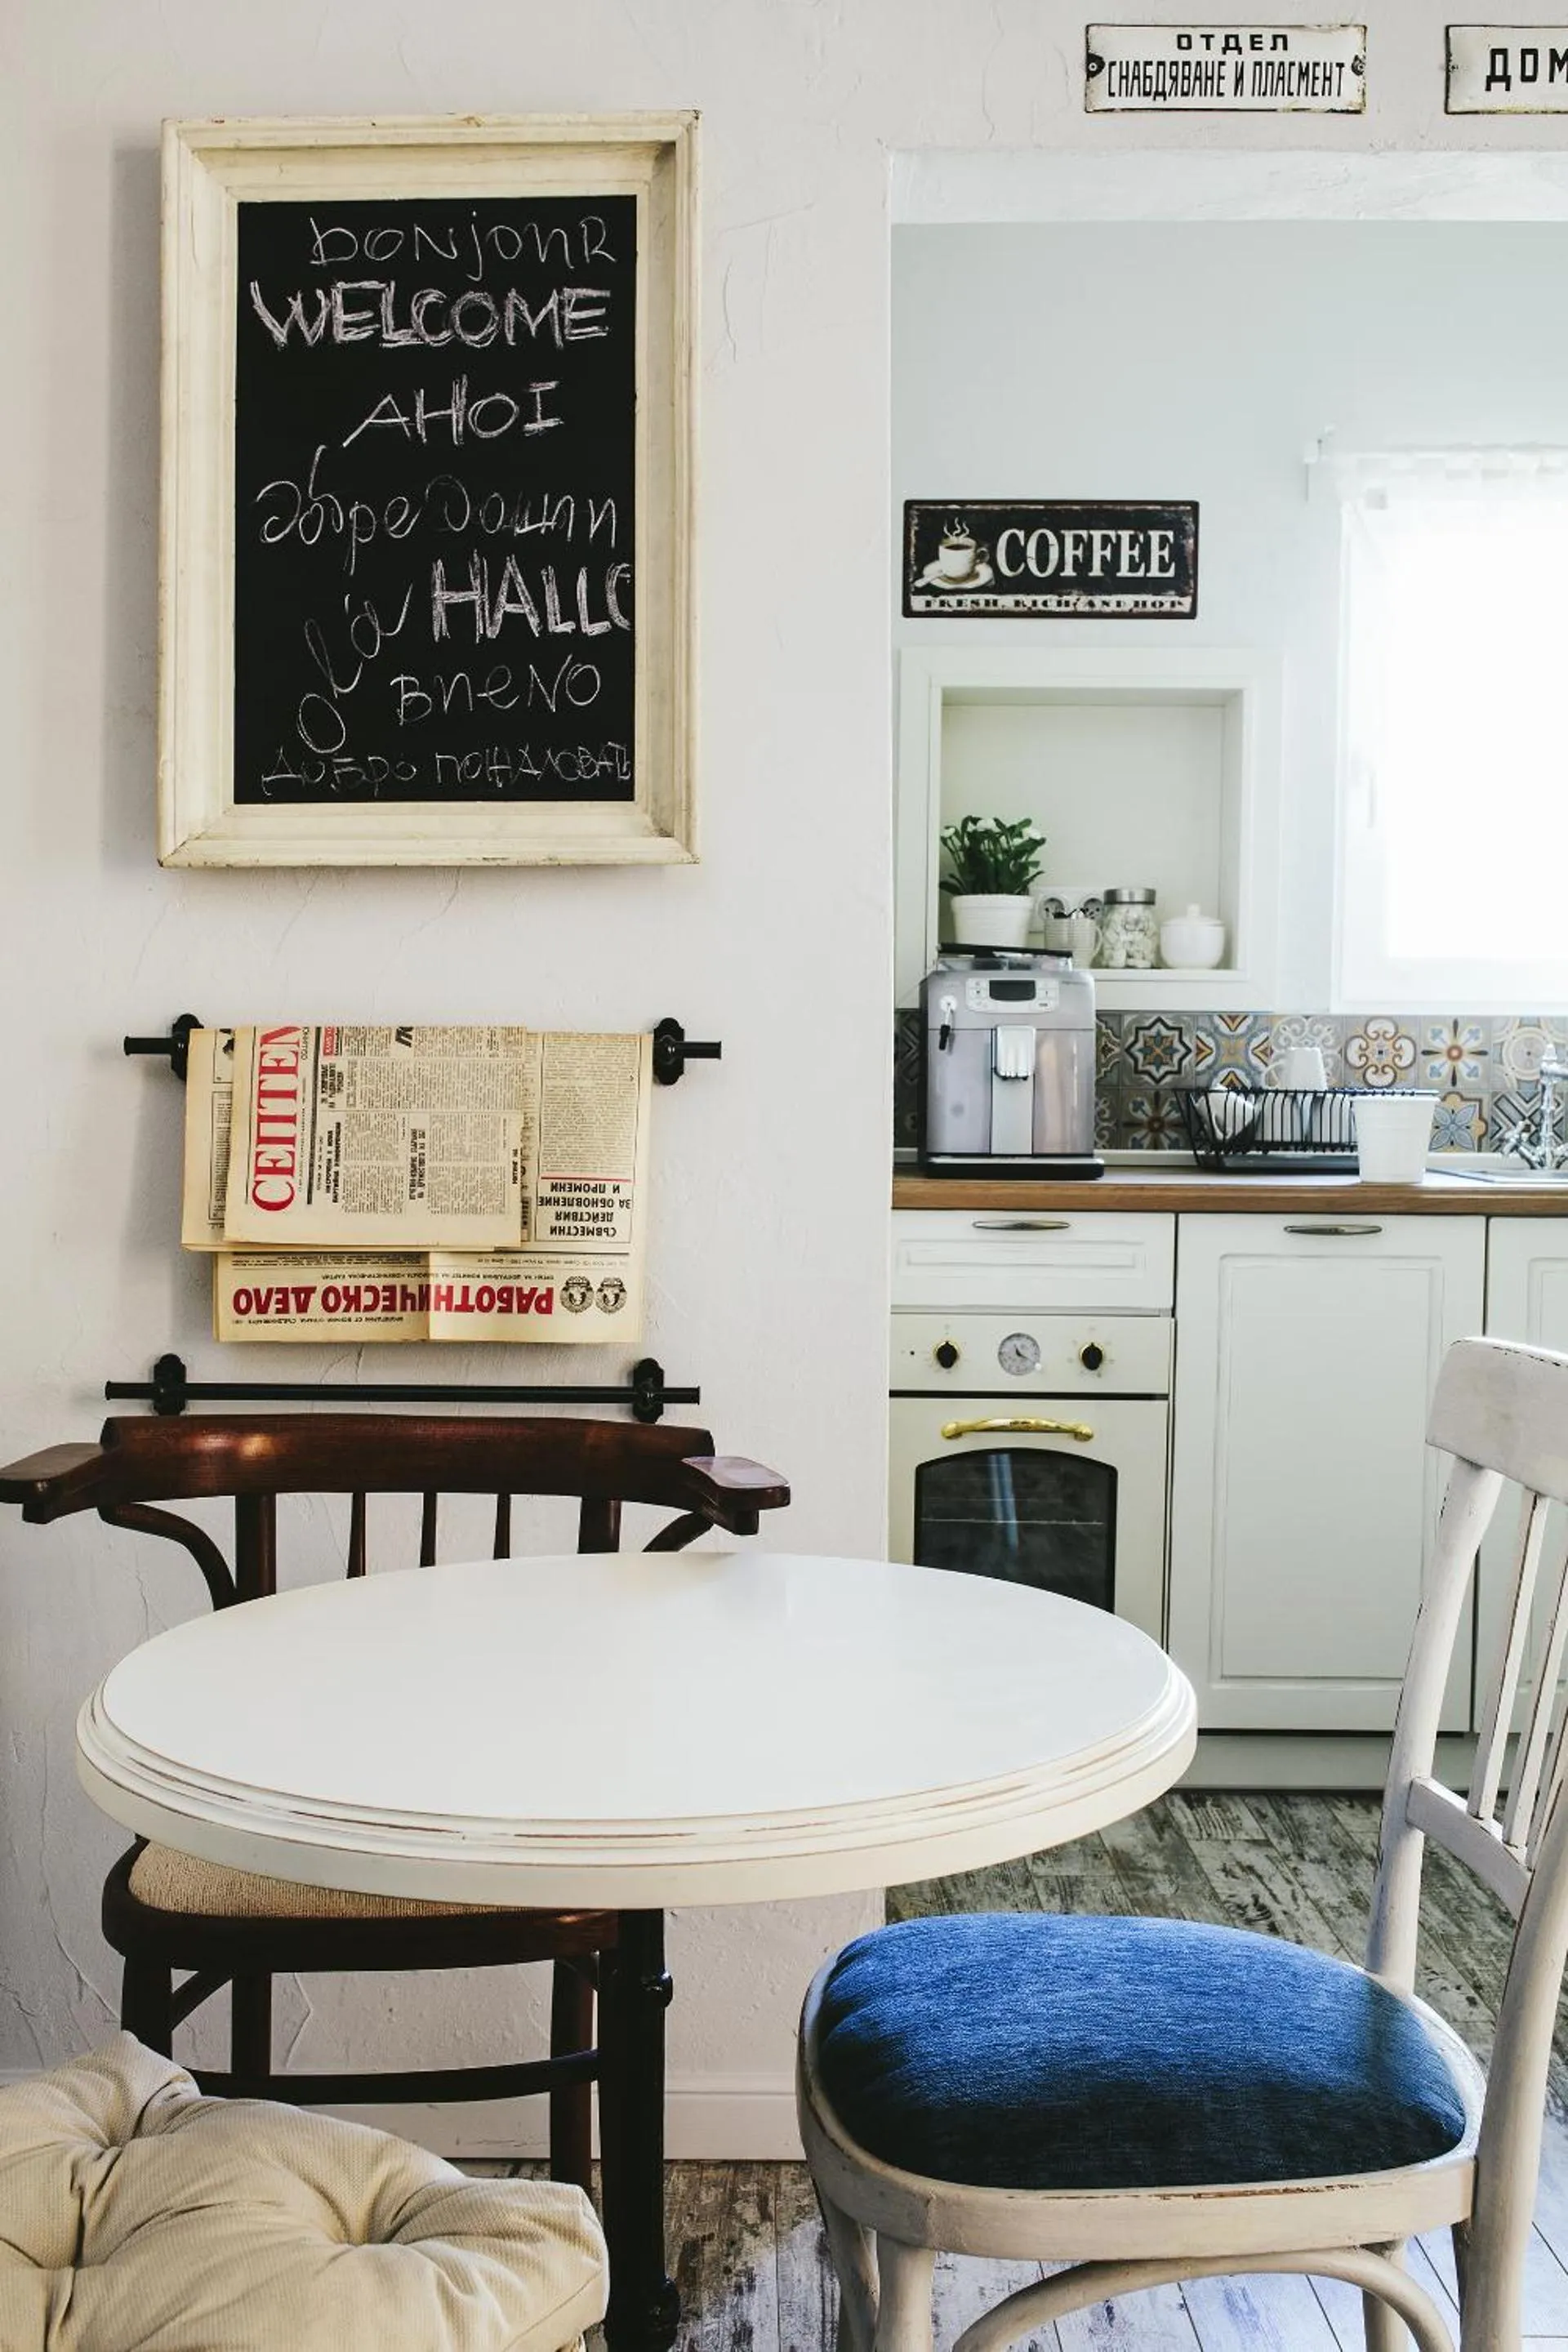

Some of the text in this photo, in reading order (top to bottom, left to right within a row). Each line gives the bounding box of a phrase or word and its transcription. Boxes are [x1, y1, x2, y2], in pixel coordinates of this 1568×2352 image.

[1176, 33, 1288, 55] ОТДЕЛ
[1107, 60, 1345, 101] СНАБДЯВАНЕ И ПЛАСМЕНТ
[250, 279, 611, 352] WELCOME
[341, 373, 564, 448] AHOI
[996, 528, 1176, 578] COFFEE
[550, 1183, 620, 1194] И ПРОМЕНИ
[538, 1196, 631, 1209] ЗА ОБНОВЛЕНИЕ
[555, 1211, 614, 1223] ДЕЙСТВИЯ
[550, 1226, 617, 1237] СЪВМЕСТНИ
[233, 1284, 555, 1316] РАБОТНИЧЕСКО ДЕЛО
